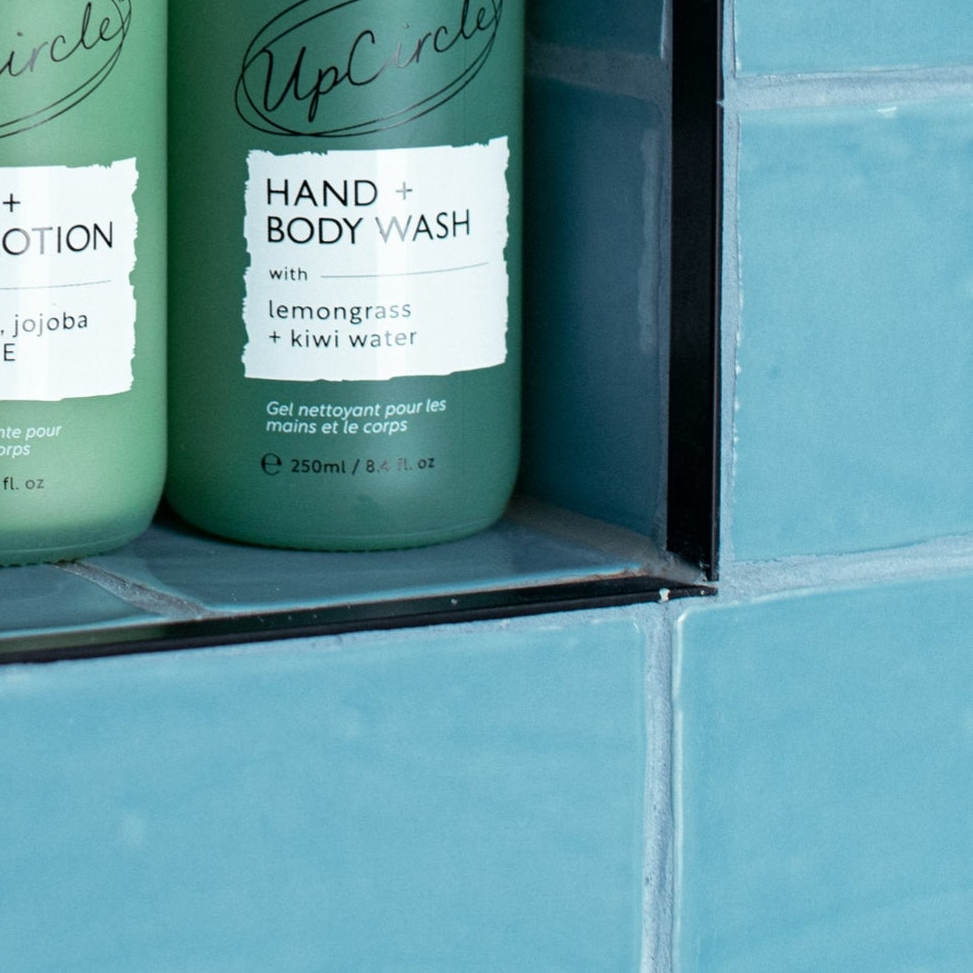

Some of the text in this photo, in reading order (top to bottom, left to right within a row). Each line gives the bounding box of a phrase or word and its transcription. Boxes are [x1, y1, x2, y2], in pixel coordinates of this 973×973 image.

[266, 178, 378, 207] HAND
[267, 209, 470, 244] BODY WASH
[269, 267, 308, 281] with
[268, 300, 411, 325] lemongrass
[12, 311, 88, 337] jojoba
[291, 329, 339, 348] kiwi
[349, 329, 417, 348] water
[3, 343, 16, 362] E
[266, 398, 447, 420] Gel nettoyant pour les
[25, 425, 62, 441] pour
[266, 419, 408, 435] mains et le corps
[291, 459, 345, 474] 250ml
[366, 459, 389, 473] 8.4
[418, 457, 435, 469] oz
[3, 476, 19, 491] fl.
[25, 478, 45, 490] oz
